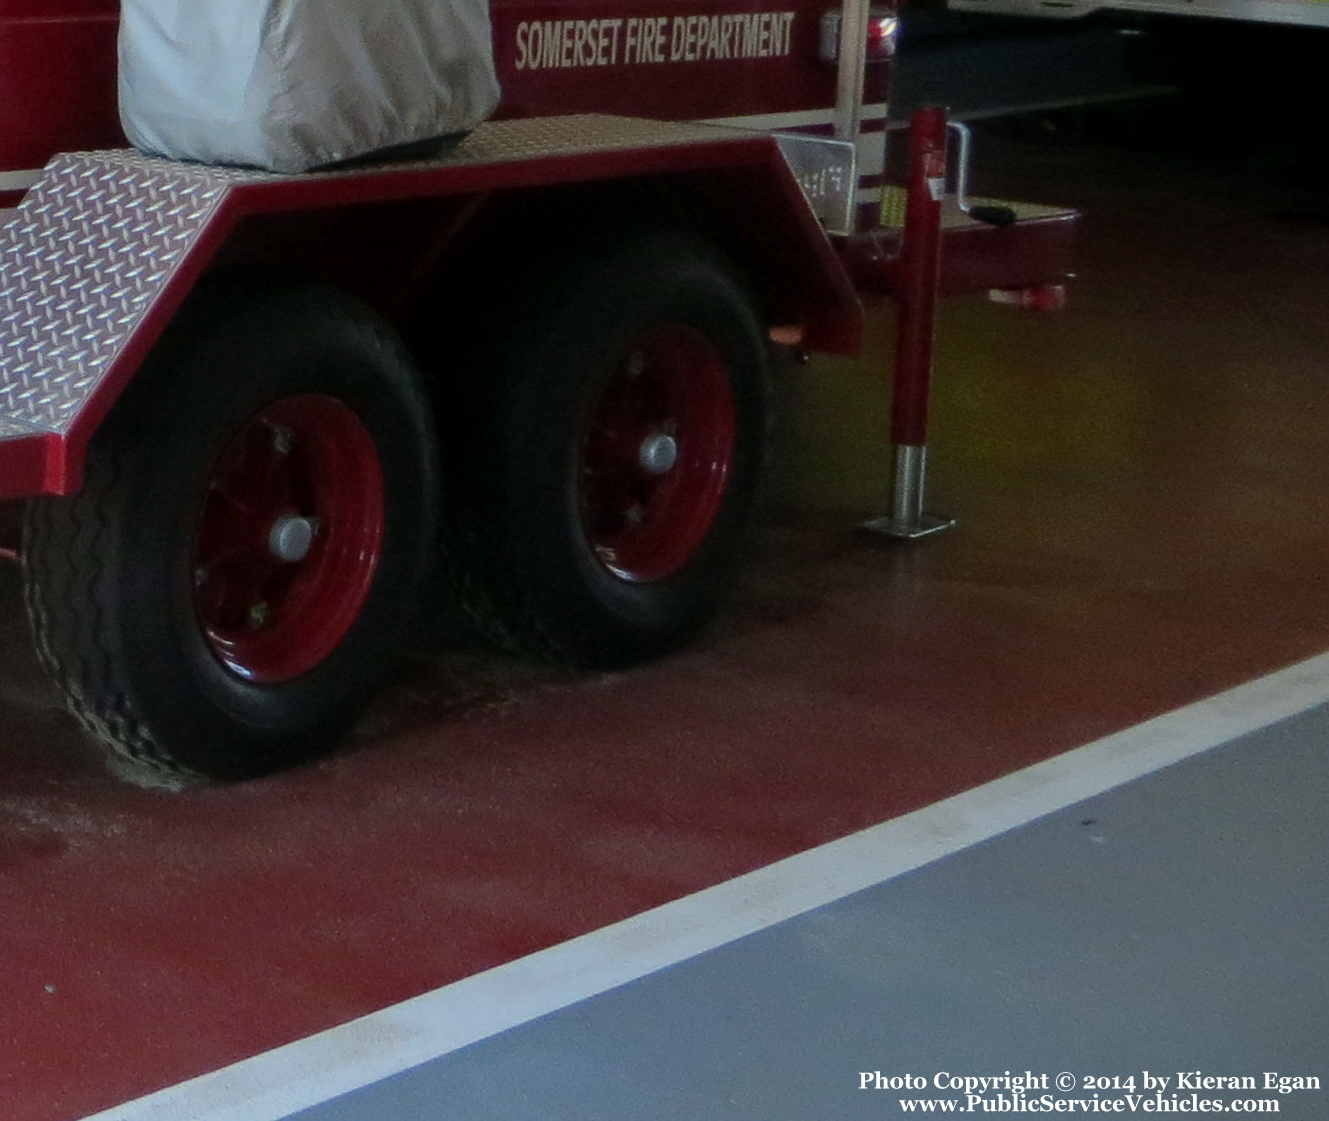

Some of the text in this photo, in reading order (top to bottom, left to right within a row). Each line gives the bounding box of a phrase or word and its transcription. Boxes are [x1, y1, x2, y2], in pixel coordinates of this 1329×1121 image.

[515, 12, 795, 70] SOMERSET FIRE DEPARTMENT
